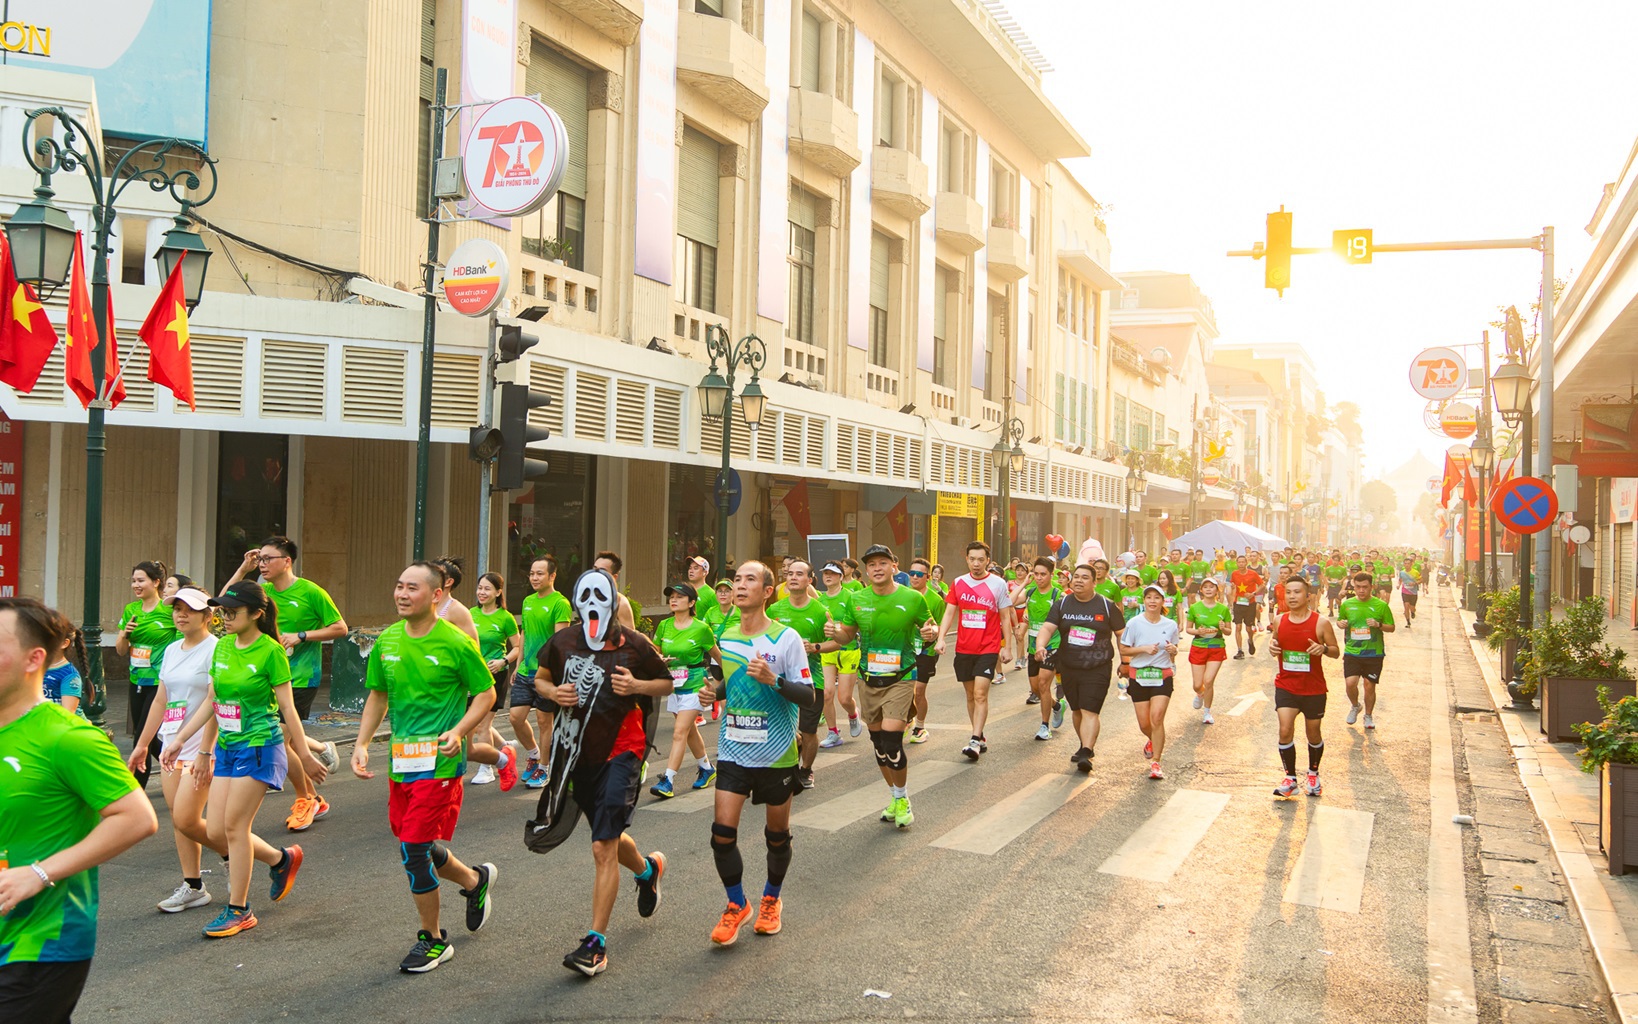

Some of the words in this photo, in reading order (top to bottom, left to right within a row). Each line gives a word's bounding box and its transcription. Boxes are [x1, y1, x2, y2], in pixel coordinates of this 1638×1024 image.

[1347, 236, 1367, 259] 19
[453, 265, 487, 276] HDBank
[0, 422, 11, 434] G
[960, 593, 977, 603] AIA
[735, 715, 762, 727] 90623
